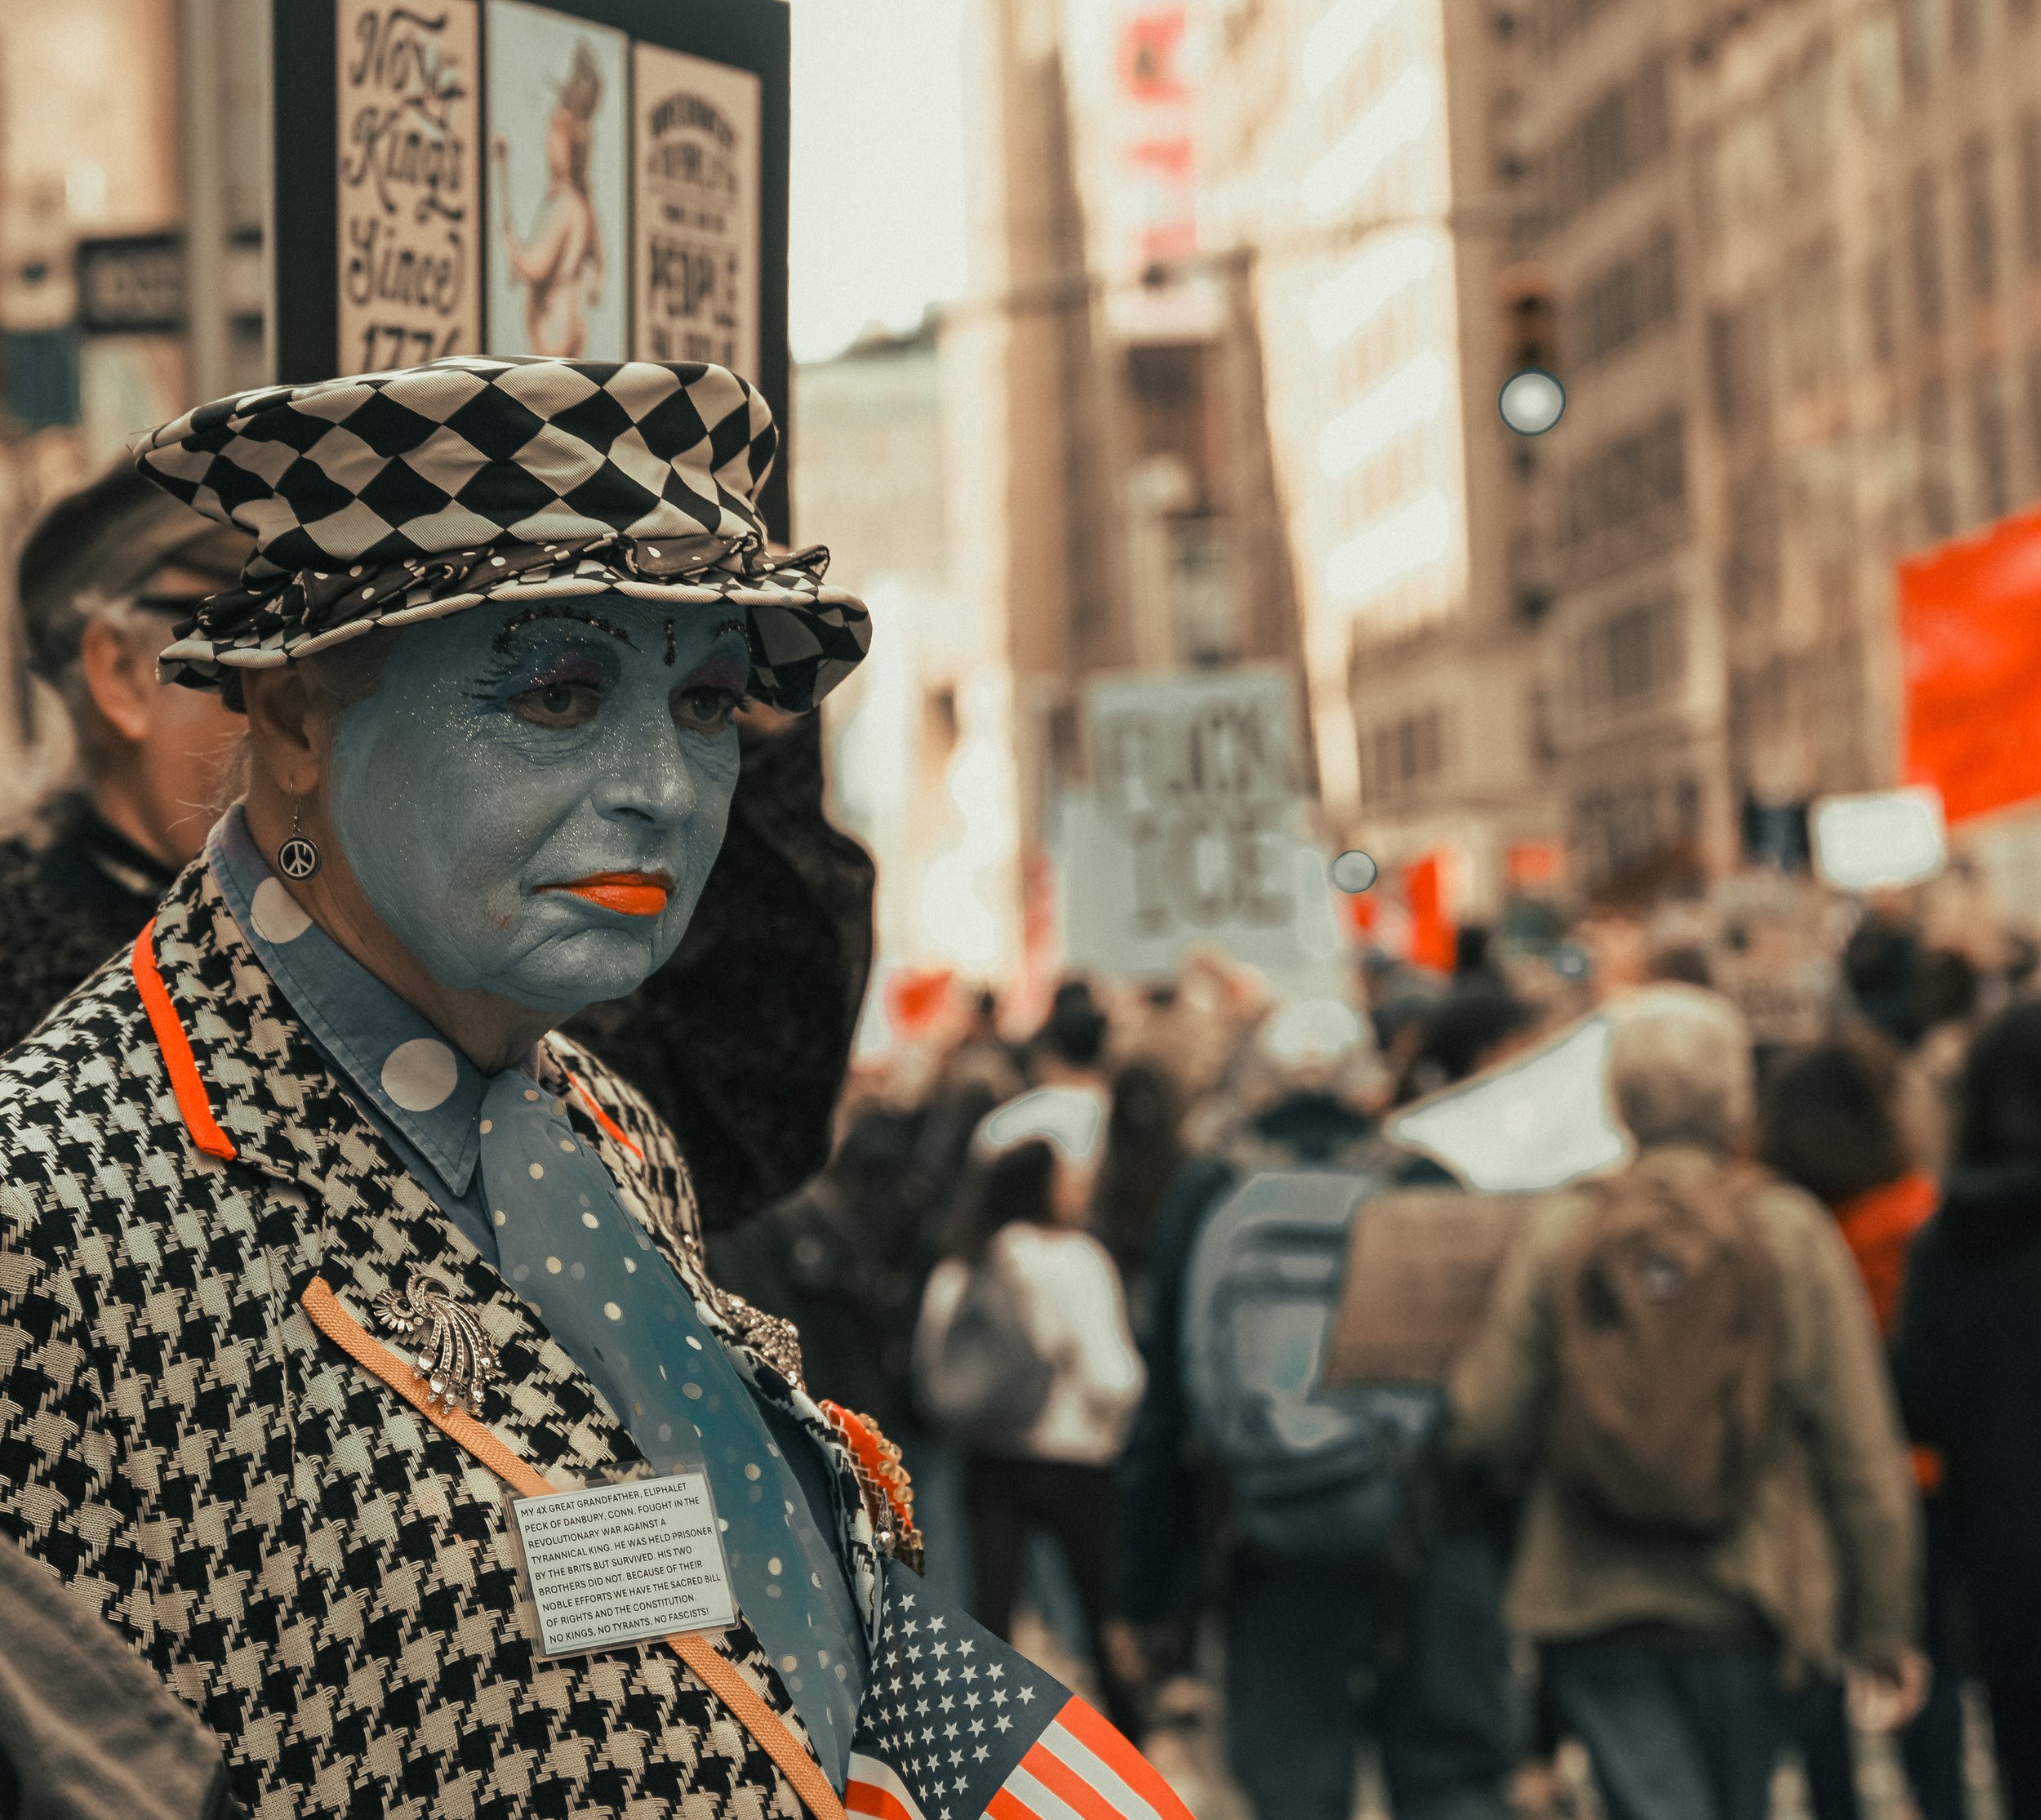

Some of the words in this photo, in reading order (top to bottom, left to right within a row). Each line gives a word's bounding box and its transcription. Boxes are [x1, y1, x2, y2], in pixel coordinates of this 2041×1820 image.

[343, 105, 465, 223] Kings
[346, 217, 465, 316] Since
[1129, 810, 1296, 939] ICE
[520, 1507, 534, 1518] MY
[536, 1506, 548, 1515] 4X
[548, 1501, 575, 1513] GREAT
[576, 1490, 643, 1508] GRANDFATHER,
[643, 1482, 687, 1497] ELIPHALET
[524, 1521, 549, 1533] PECK
[549, 1519, 562, 1529] OF
[562, 1512, 607, 1527] DANBURY,
[607, 1507, 637, 1520] CONN.
[637, 1500, 672, 1514] FOUGHT
[674, 1499, 683, 1508] IN
[683, 1496, 700, 1506] THE
[527, 1529, 599, 1550] REVOLUTIONARY
[600, 1525, 622, 1536] WAR
[623, 1519, 658, 1533] AGAINST
[660, 1518, 667, 1527] A
[531, 1547, 588, 1565] TYRANNICAL
[588, 1543, 613, 1555] KING.
[613, 1540, 627, 1551] HE
[626, 1537, 647, 1548] WAS
[647, 1533, 671, 1545] HELD
[672, 1526, 713, 1541] PRISONER
[535, 1570, 546, 1581] BY
[547, 1567, 567, 1578] THE
[567, 1563, 593, 1575] BRITS
[593, 1559, 610, 1570] BUT
[611, 1552, 656, 1567] SURVIVED.
[656, 1549, 673, 1560] HIS
[672, 1546, 692, 1556] TWO
[538, 1580, 587, 1596] BROTHERS
[587, 1577, 604, 1587] DID
[604, 1573, 625, 1584] NOT.
[625, 1566, 665, 1581] BECAUSE
[665, 1564, 678, 1573] OF
[678, 1560, 703, 1572] THEIR
[541, 1598, 574, 1613] NOBLE
[574, 1591, 613, 1606] EFFORTS
[612, 1588, 629, 1599] WE
[628, 1584, 652, 1596] HAVE
[651, 1582, 669, 1592] THE
[669, 1576, 703, 1589] SACRED
[704, 1573, 721, 1583] BILL
[545, 1618, 558, 1628] OF
[560, 1611, 594, 1625] RIGHTS
[594, 1608, 614, 1619] AND
[614, 1604, 632, 1615] THE
[633, 1594, 697, 1612] CONSTITUTION.
[549, 1633, 564, 1644] NO
[565, 1627, 597, 1641] KINGS,
[597, 1624, 611, 1635] NO
[611, 1618, 653, 1631] TYRANTS,
[654, 1614, 667, 1624] NO
[668, 1607, 709, 1622] FASCISTS!
